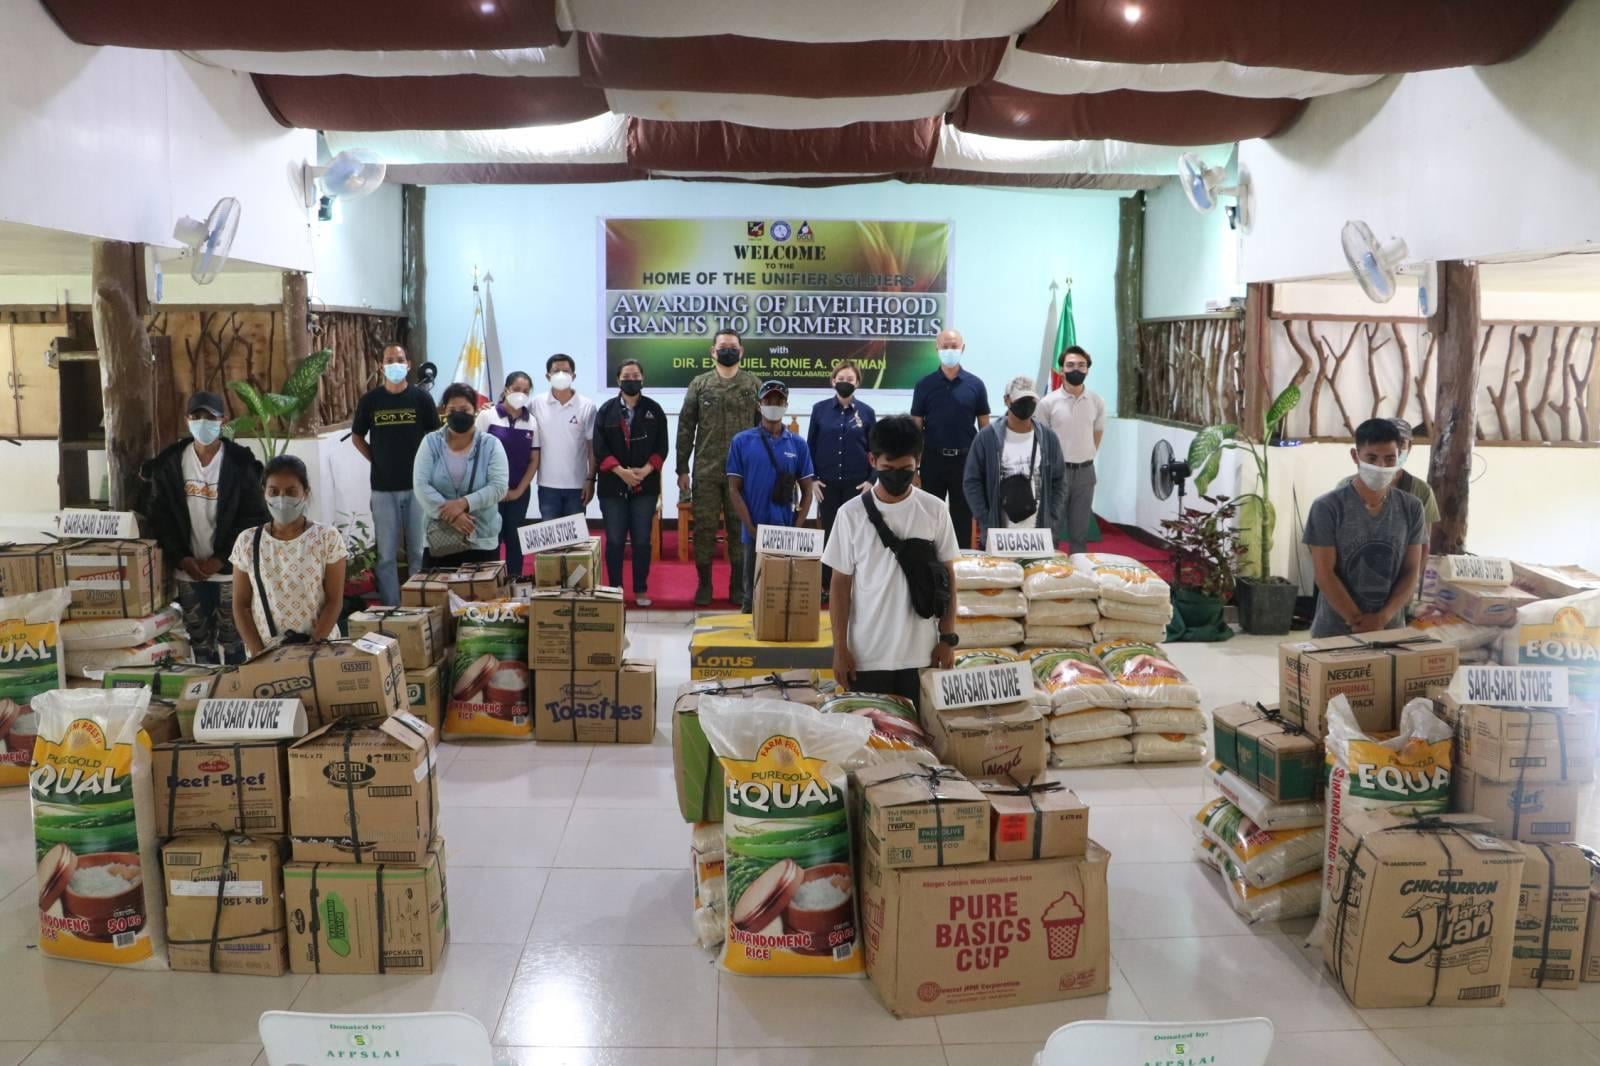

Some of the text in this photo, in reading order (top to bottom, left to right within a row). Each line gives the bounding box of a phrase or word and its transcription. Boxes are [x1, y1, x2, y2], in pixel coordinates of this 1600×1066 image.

[733, 245, 826, 261] WELCOME
[642, 272, 915, 288] HOME OF THE UNIFIER SOLDIERS
[613, 295, 938, 317] AWARDING OF LIVELIHOOD
[609, 315, 943, 338] GRANTS TO FORMER REBELS
[769, 345, 789, 354] with
[672, 358, 698, 369] DIR.
[770, 358, 808, 369] RONIE
[815, 358, 827, 369] A.
[831, 358, 887, 370] GMAN
[63, 514, 121, 536] SARI-SARI STORE
[524, 520, 578, 550] SARI-SARI STORE
[762, 529, 815, 553] CARPENTRY TOOLS
[996, 533, 1045, 552] BIGASAN
[1456, 559, 1505, 580] SARI-SARI STORE
[463, 606, 525, 625] QUAL
[696, 656, 753, 666] LOTUS
[699, 669, 732, 677] 1800W
[1327, 663, 1372, 681] NESCAFÉ
[190, 684, 201, 695] 4
[254, 675, 314, 698] OREO
[942, 667, 1021, 706] SARI-SARI STORE
[1329, 683, 1371, 696] ORIGINAL
[1467, 669, 1553, 702] SARI-SARI STORE
[544, 697, 642, 724] Toasties
[1352, 698, 1375, 708] PACK
[200, 700, 283, 729] SARI-SARI STORE
[760, 738, 783, 757] FARM
[338, 763, 366, 771] DTU
[338, 772, 361, 781] PTI
[751, 770, 812, 782] PUREGOLD
[30, 761, 121, 797] QUAL
[729, 778, 838, 813] EQUAL
[1327, 766, 1345, 862] SINANDOMENG
[1399, 880, 1499, 897] CHICHARRON
[223, 897, 241, 906] 150
[255, 897, 269, 905] 48
[949, 891, 1018, 921] PURE
[107, 917, 127, 933] 50
[935, 918, 1032, 948] BASICS
[730, 924, 812, 947] SINANDOMENG
[745, 946, 770, 960] RICE
[955, 945, 1009, 973] CUP
[371, 1023, 385, 1031] by:
[1154, 1031, 1209, 1041] Donated by:
